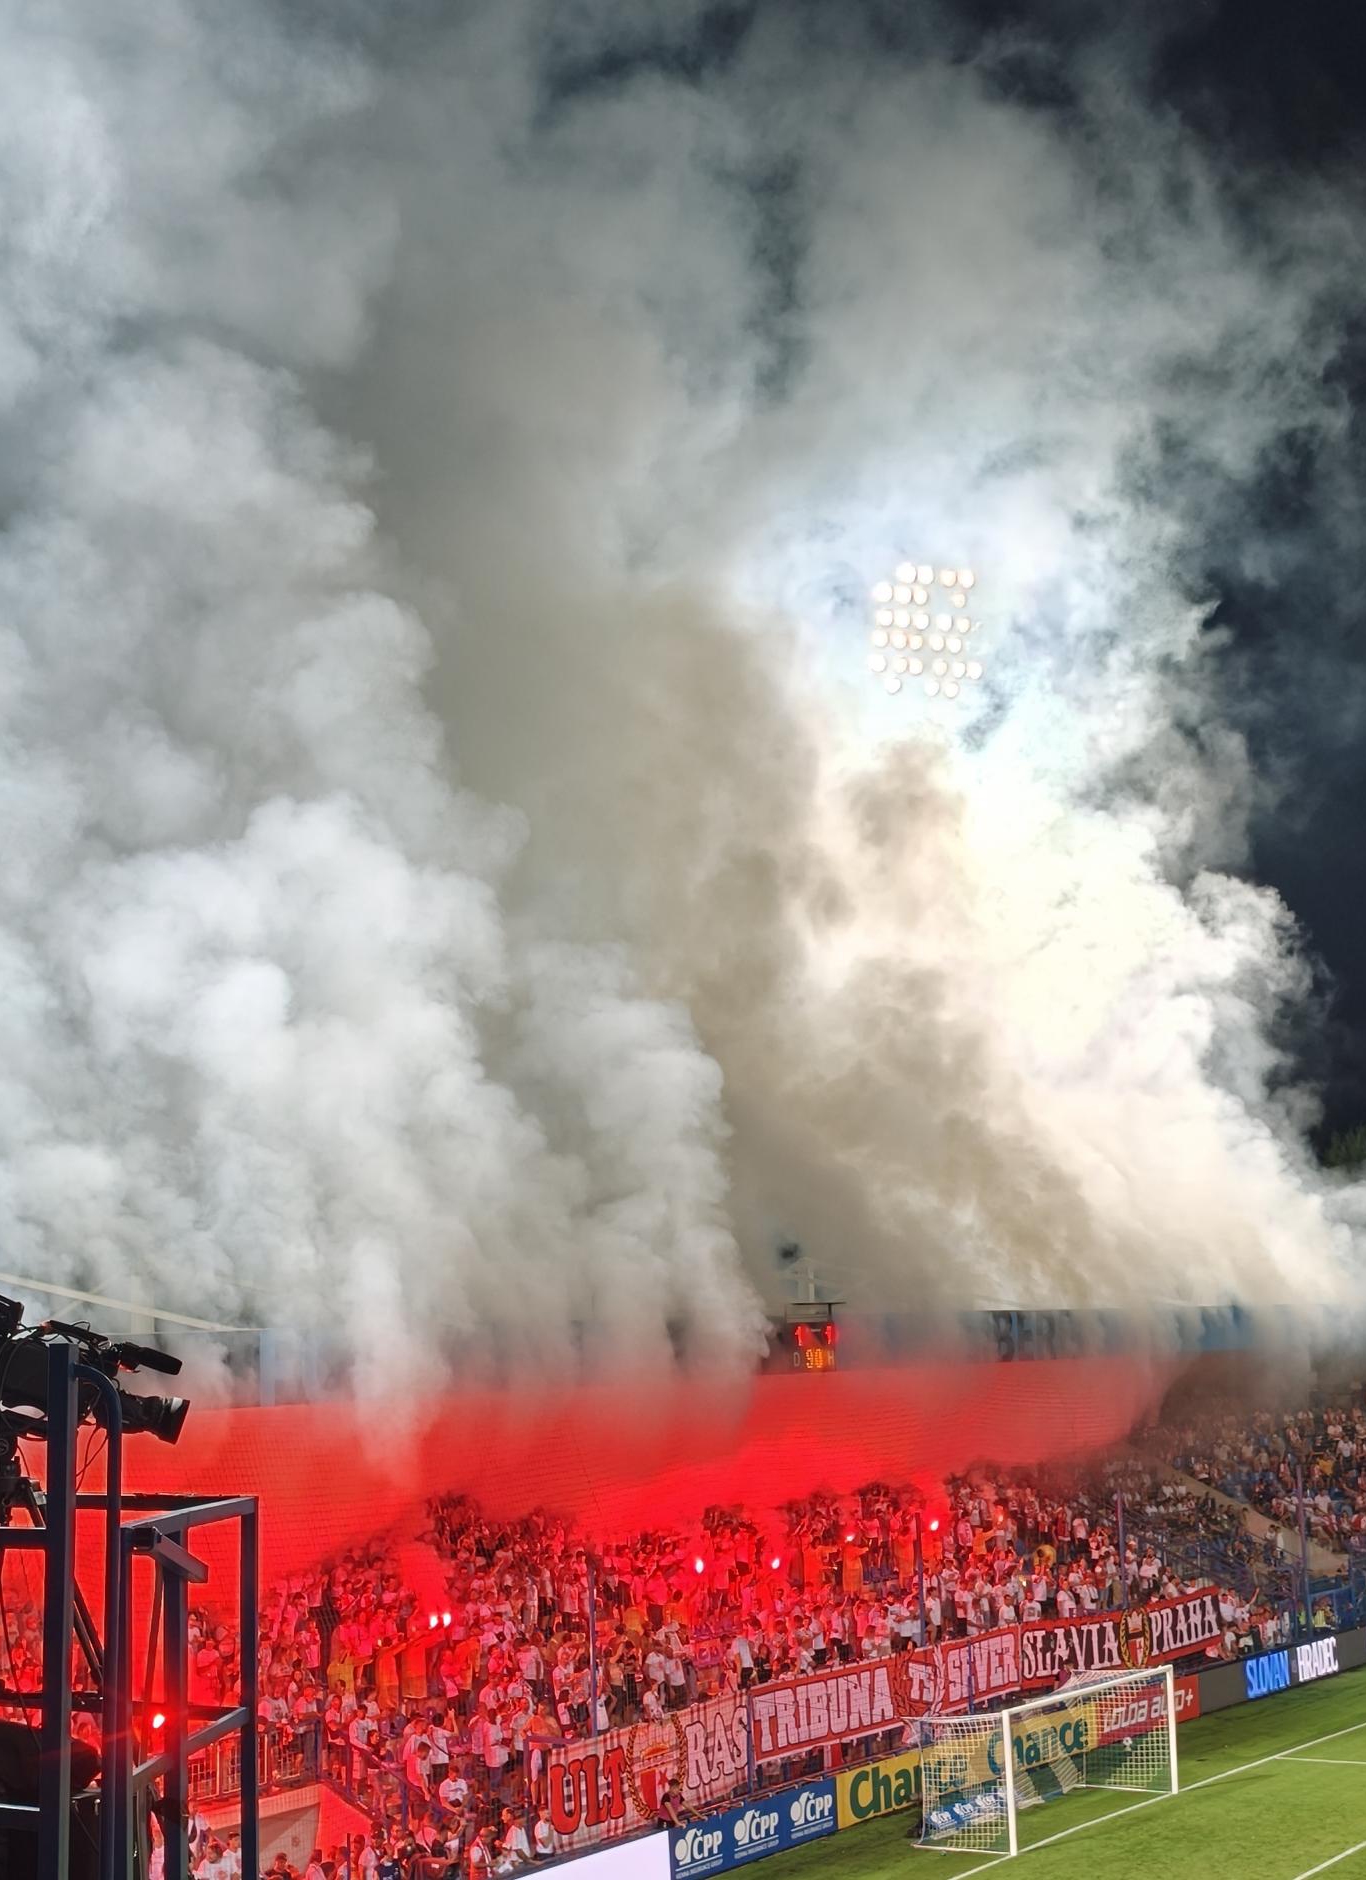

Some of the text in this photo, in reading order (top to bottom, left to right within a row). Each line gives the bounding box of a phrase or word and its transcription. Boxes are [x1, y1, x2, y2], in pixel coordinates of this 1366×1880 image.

[806, 1348, 823, 1368] 90
[1022, 1594, 1221, 1680] SLAVIA PRAHA
[947, 1632, 1020, 1702] SEVER
[1245, 1636, 1339, 1699] SLOVAN HRADEC
[752, 1666, 894, 1753] TRIBUNA
[750, 1810, 779, 1841] ČPP
[806, 1792, 833, 1821] ČPP
[692, 1829, 723, 1860] ČPP
